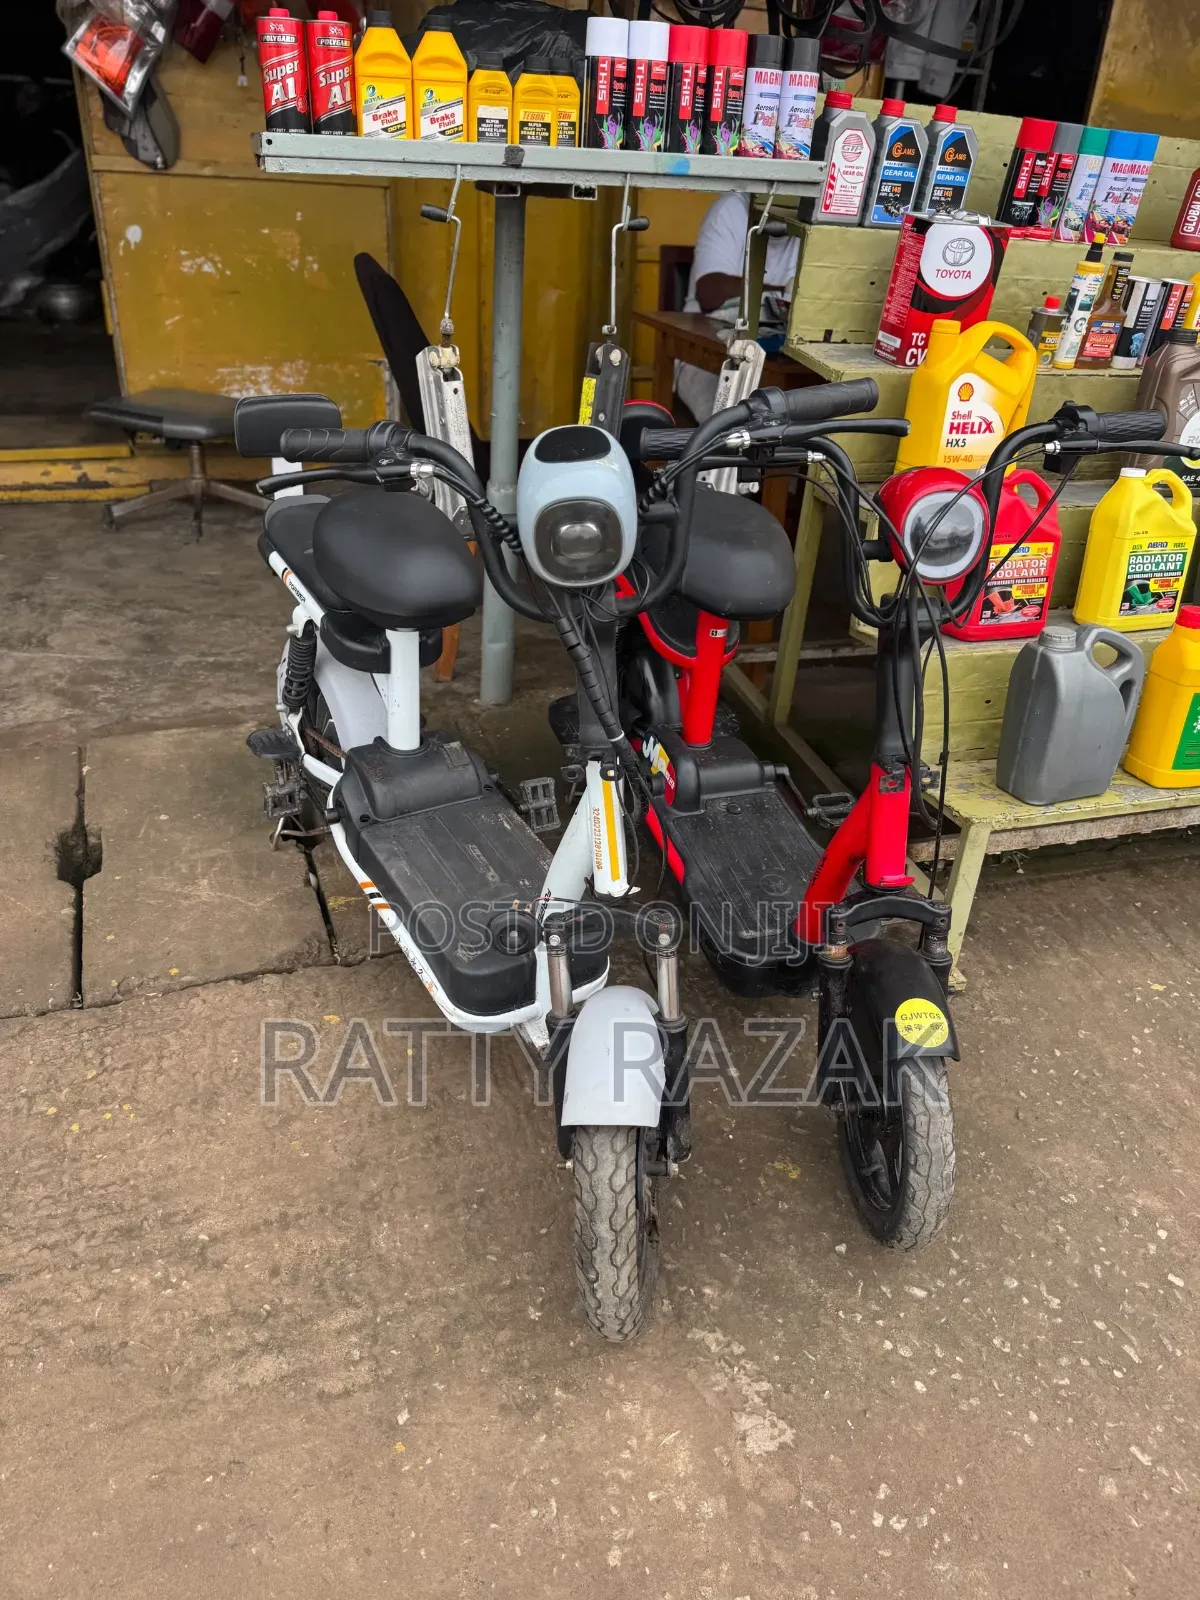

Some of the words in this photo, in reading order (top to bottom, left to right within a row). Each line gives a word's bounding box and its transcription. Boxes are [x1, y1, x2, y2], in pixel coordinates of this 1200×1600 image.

[262, 35, 296, 43] POLYGARD
[264, 60, 298, 84] Super
[599, 60, 608, 101] THIS
[634, 63, 645, 103] THIS
[681, 66, 693, 107] THIS
[712, 69, 724, 109] THIS
[372, 109, 398, 122] Brake
[789, 105, 809, 114] Aerosol
[381, 117, 399, 126] Fluid
[429, 112, 455, 125] Brake
[438, 120, 456, 129] Fluid
[841, 145, 864, 153] GTP
[892, 142, 916, 158] GLAMS
[945, 147, 967, 163] GLAMS
[884, 169, 903, 177] GEAR
[936, 173, 955, 181] GEAR
[1017, 158, 1032, 189] THIS
[1041, 156, 1056, 186] THIS
[823, 162, 836, 211] GTP
[880, 185, 891, 193] SAE
[933, 189, 943, 197] SAE
[936, 268, 972, 280] TOYOTA
[1165, 289, 1180, 318] THIS
[912, 332, 926, 346] TC
[905, 347, 928, 366] CV
[951, 410, 973, 421] Shell
[948, 421, 995, 435] HELIX
[945, 438, 966, 448] HX5
[943, 454, 973, 464] 15W-40
[1147, 541, 1168, 549] ABRO
[1129, 553, 1183, 564] RADIATOR
[992, 567, 1047, 579] OOLANT
[1128, 561, 1182, 573] COOLANT
[900, 1012, 941, 1021] GJWTGS
